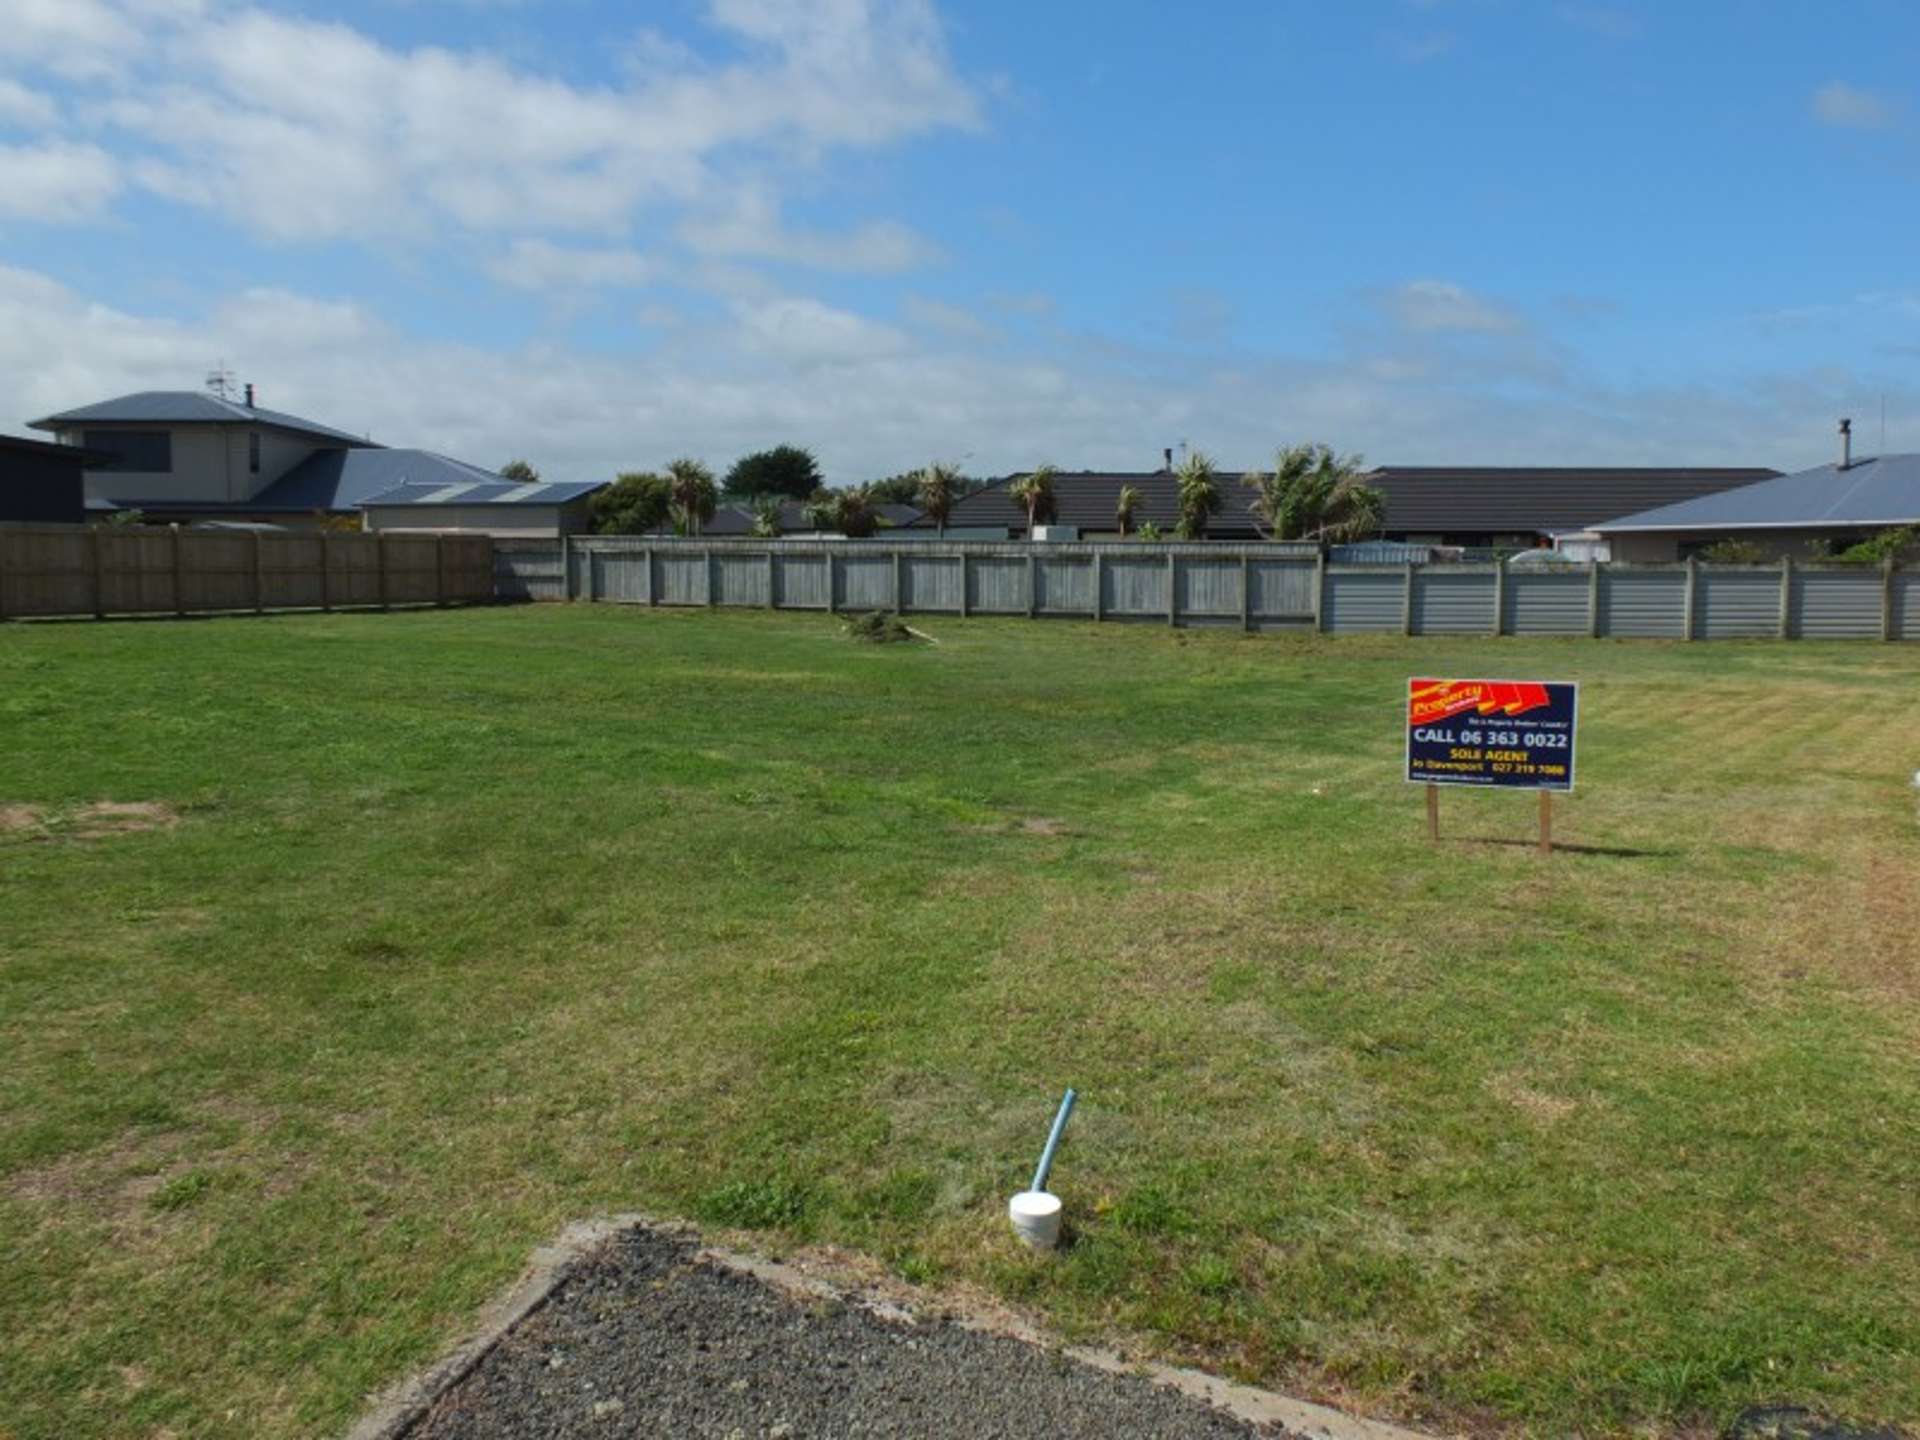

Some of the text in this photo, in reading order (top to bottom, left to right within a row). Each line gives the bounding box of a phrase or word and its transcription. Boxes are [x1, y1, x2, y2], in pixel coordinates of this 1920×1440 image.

[1414, 728, 1568, 748] CALL 06 363 0022
[1450, 748, 1529, 762] SOLE AGENT
